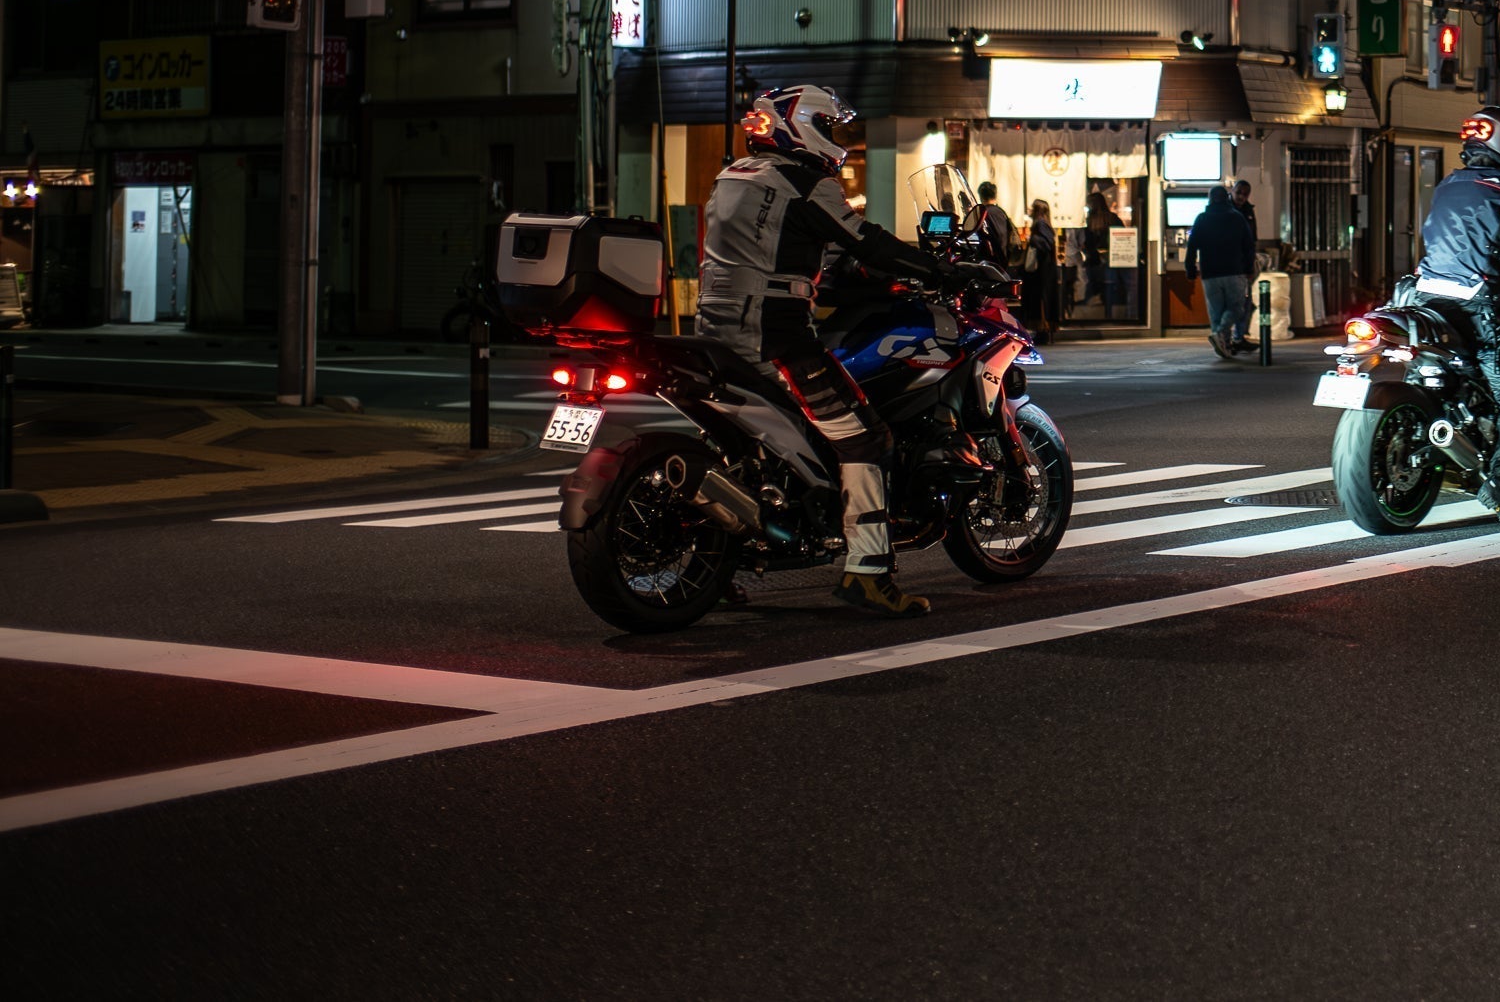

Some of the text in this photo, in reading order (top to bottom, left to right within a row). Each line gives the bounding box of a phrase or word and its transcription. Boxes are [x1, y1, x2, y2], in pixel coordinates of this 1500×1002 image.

[122, 50, 204, 81] コインロッカー
[105, 88, 182, 111] 24時間営業
[982, 370, 1002, 386] GS
[547, 419, 593, 443] 55-56
